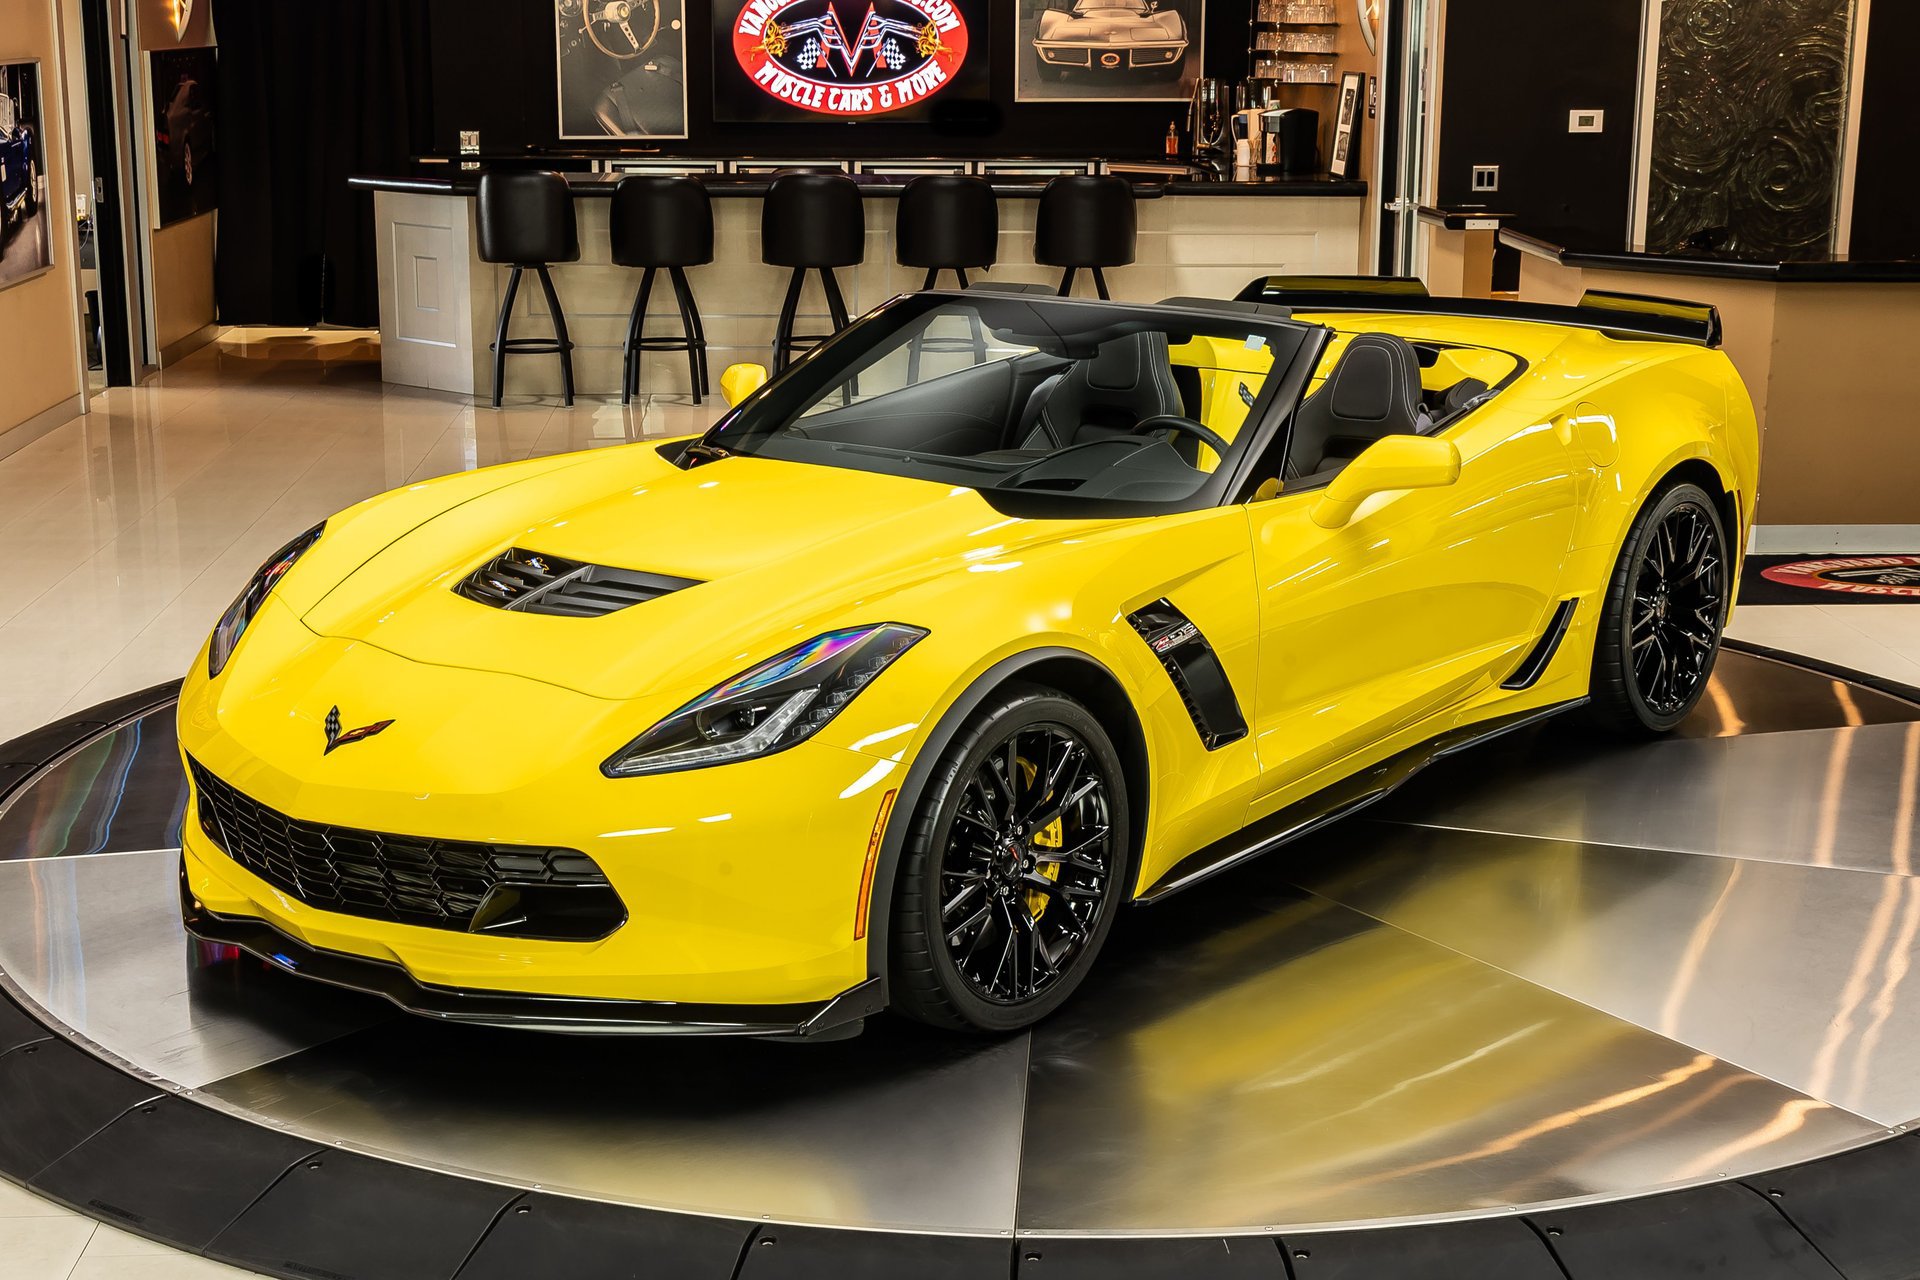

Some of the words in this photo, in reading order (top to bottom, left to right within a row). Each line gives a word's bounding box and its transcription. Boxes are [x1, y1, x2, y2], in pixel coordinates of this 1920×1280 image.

[754, 60, 827, 109] MUSCLE
[827, 87, 874, 112] CARS
[878, 85, 893, 108] &
[894, 60, 948, 104] MORE
[1772, 557, 1905, 575] VANGUARD
